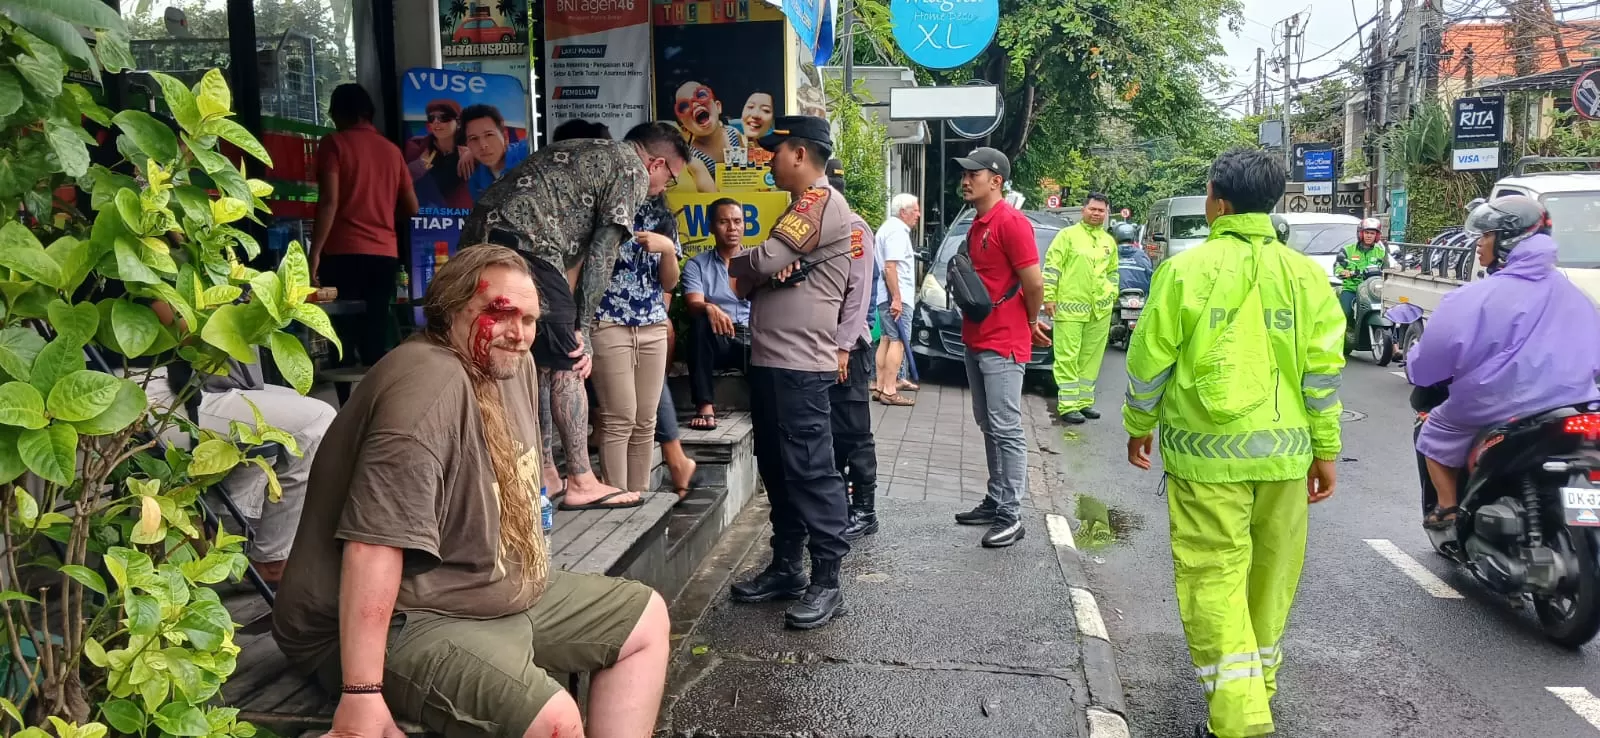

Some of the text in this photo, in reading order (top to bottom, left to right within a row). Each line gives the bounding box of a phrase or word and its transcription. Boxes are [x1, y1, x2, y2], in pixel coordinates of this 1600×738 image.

[664, 3, 698, 21] THE
[913, 23, 974, 52] XL
[1459, 110, 1495, 126] RITA
[1458, 154, 1480, 163] VISA
[1313, 194, 1362, 206] COMO
[418, 207, 470, 216] EBASKAN
[410, 217, 454, 230] TIAP
[683, 204, 761, 237] WB
[1568, 492, 1585, 505] DK
